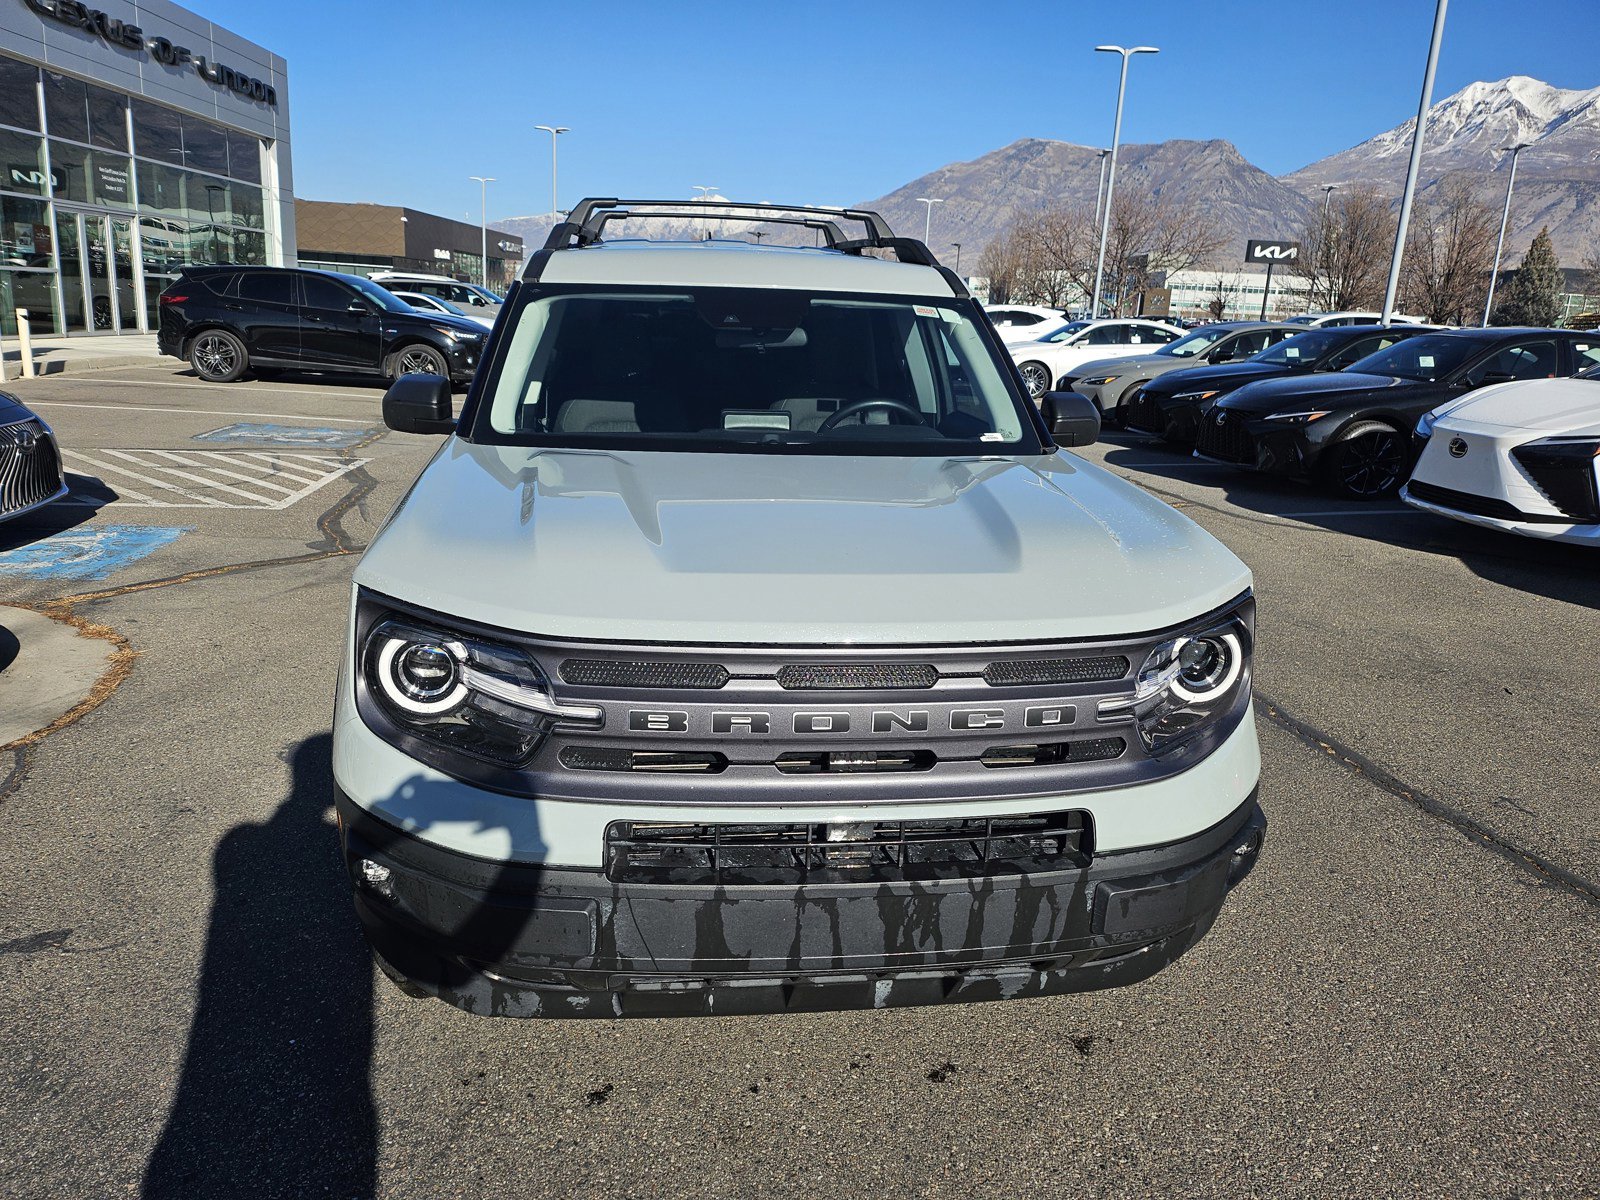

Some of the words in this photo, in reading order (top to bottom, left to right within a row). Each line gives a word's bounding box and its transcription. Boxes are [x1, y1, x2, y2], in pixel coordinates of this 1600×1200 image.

[149, 36, 191, 66] OF
[195, 56, 277, 106] LINDON
[1253, 244, 1298, 259] KIA
[628, 704, 1078, 734] BRONCO
